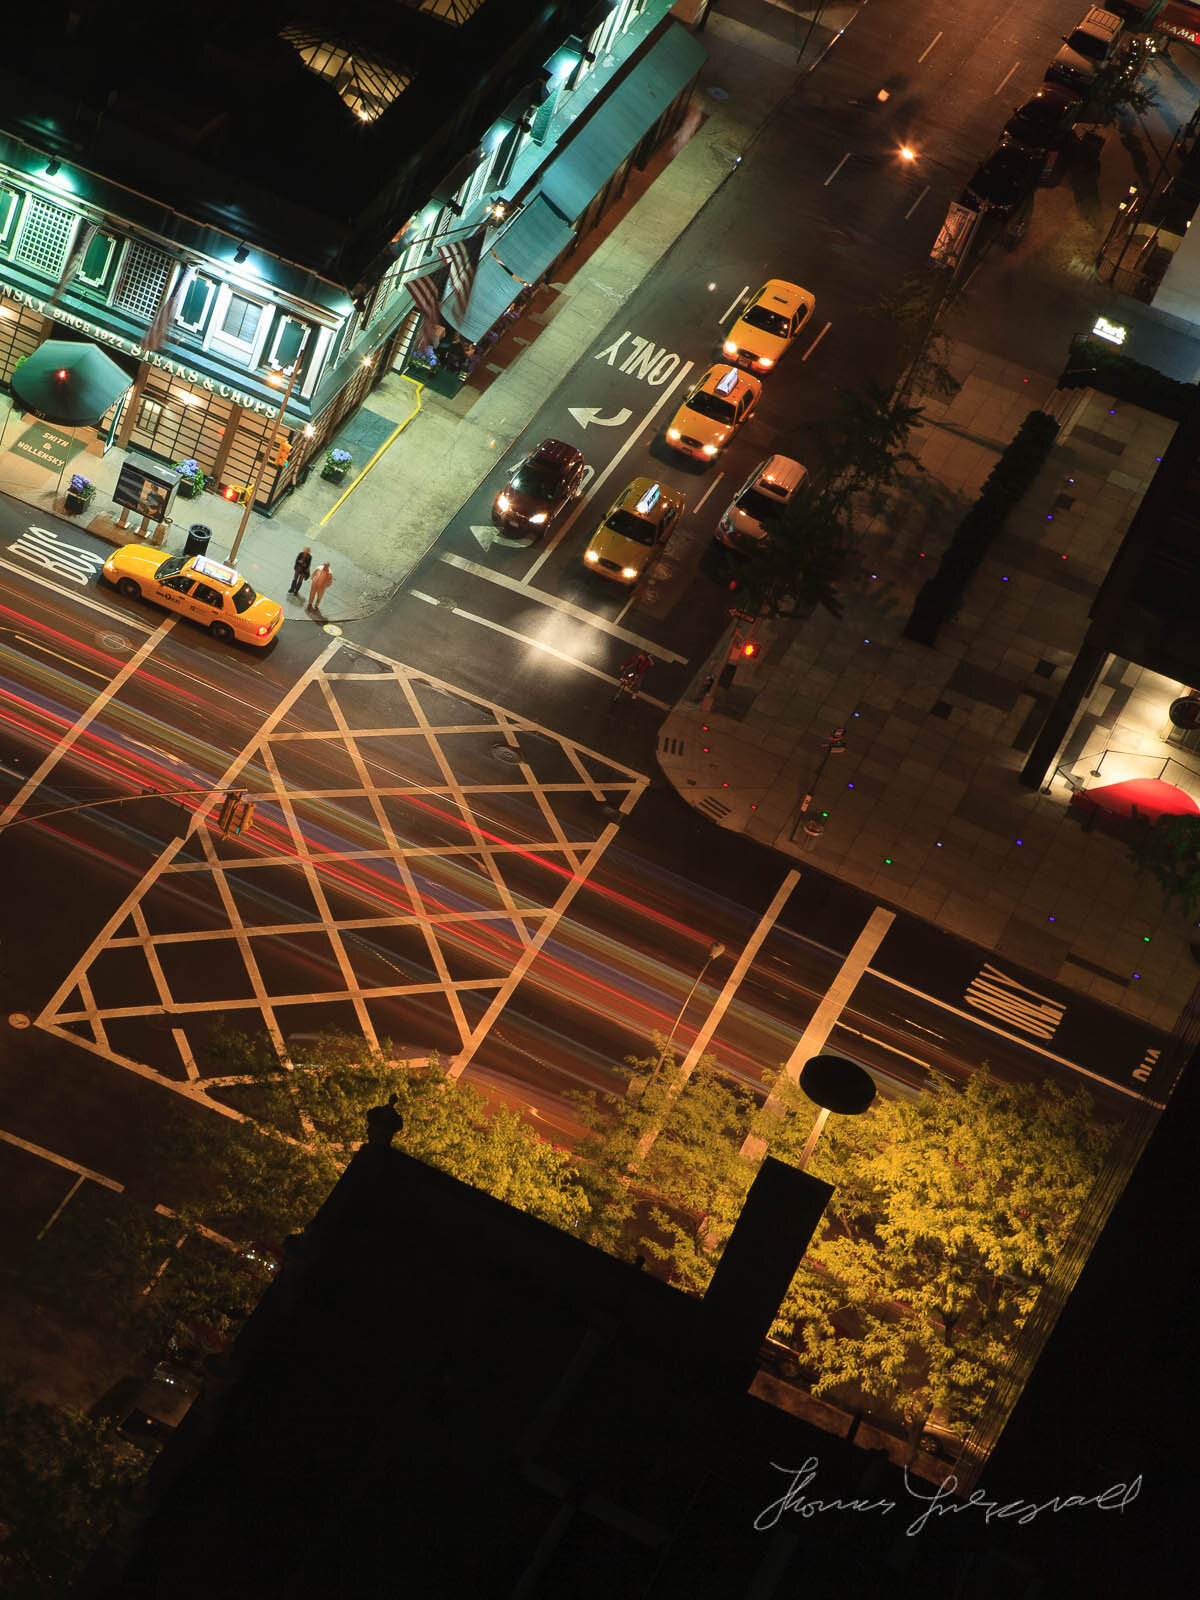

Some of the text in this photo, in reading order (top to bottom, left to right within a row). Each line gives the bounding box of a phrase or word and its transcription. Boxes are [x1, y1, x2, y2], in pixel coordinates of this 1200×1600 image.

[53, 309, 90, 332] SINCE
[130, 343, 198, 384] STEAKS
[202, 377, 214, 392] &
[219, 384, 278, 420] CHOPS
[594, 330, 681, 386] ONLY
[42, 432, 70, 448] SMITH
[5, 525, 104, 586] BUS
[963, 962, 1068, 1040] ONLY
